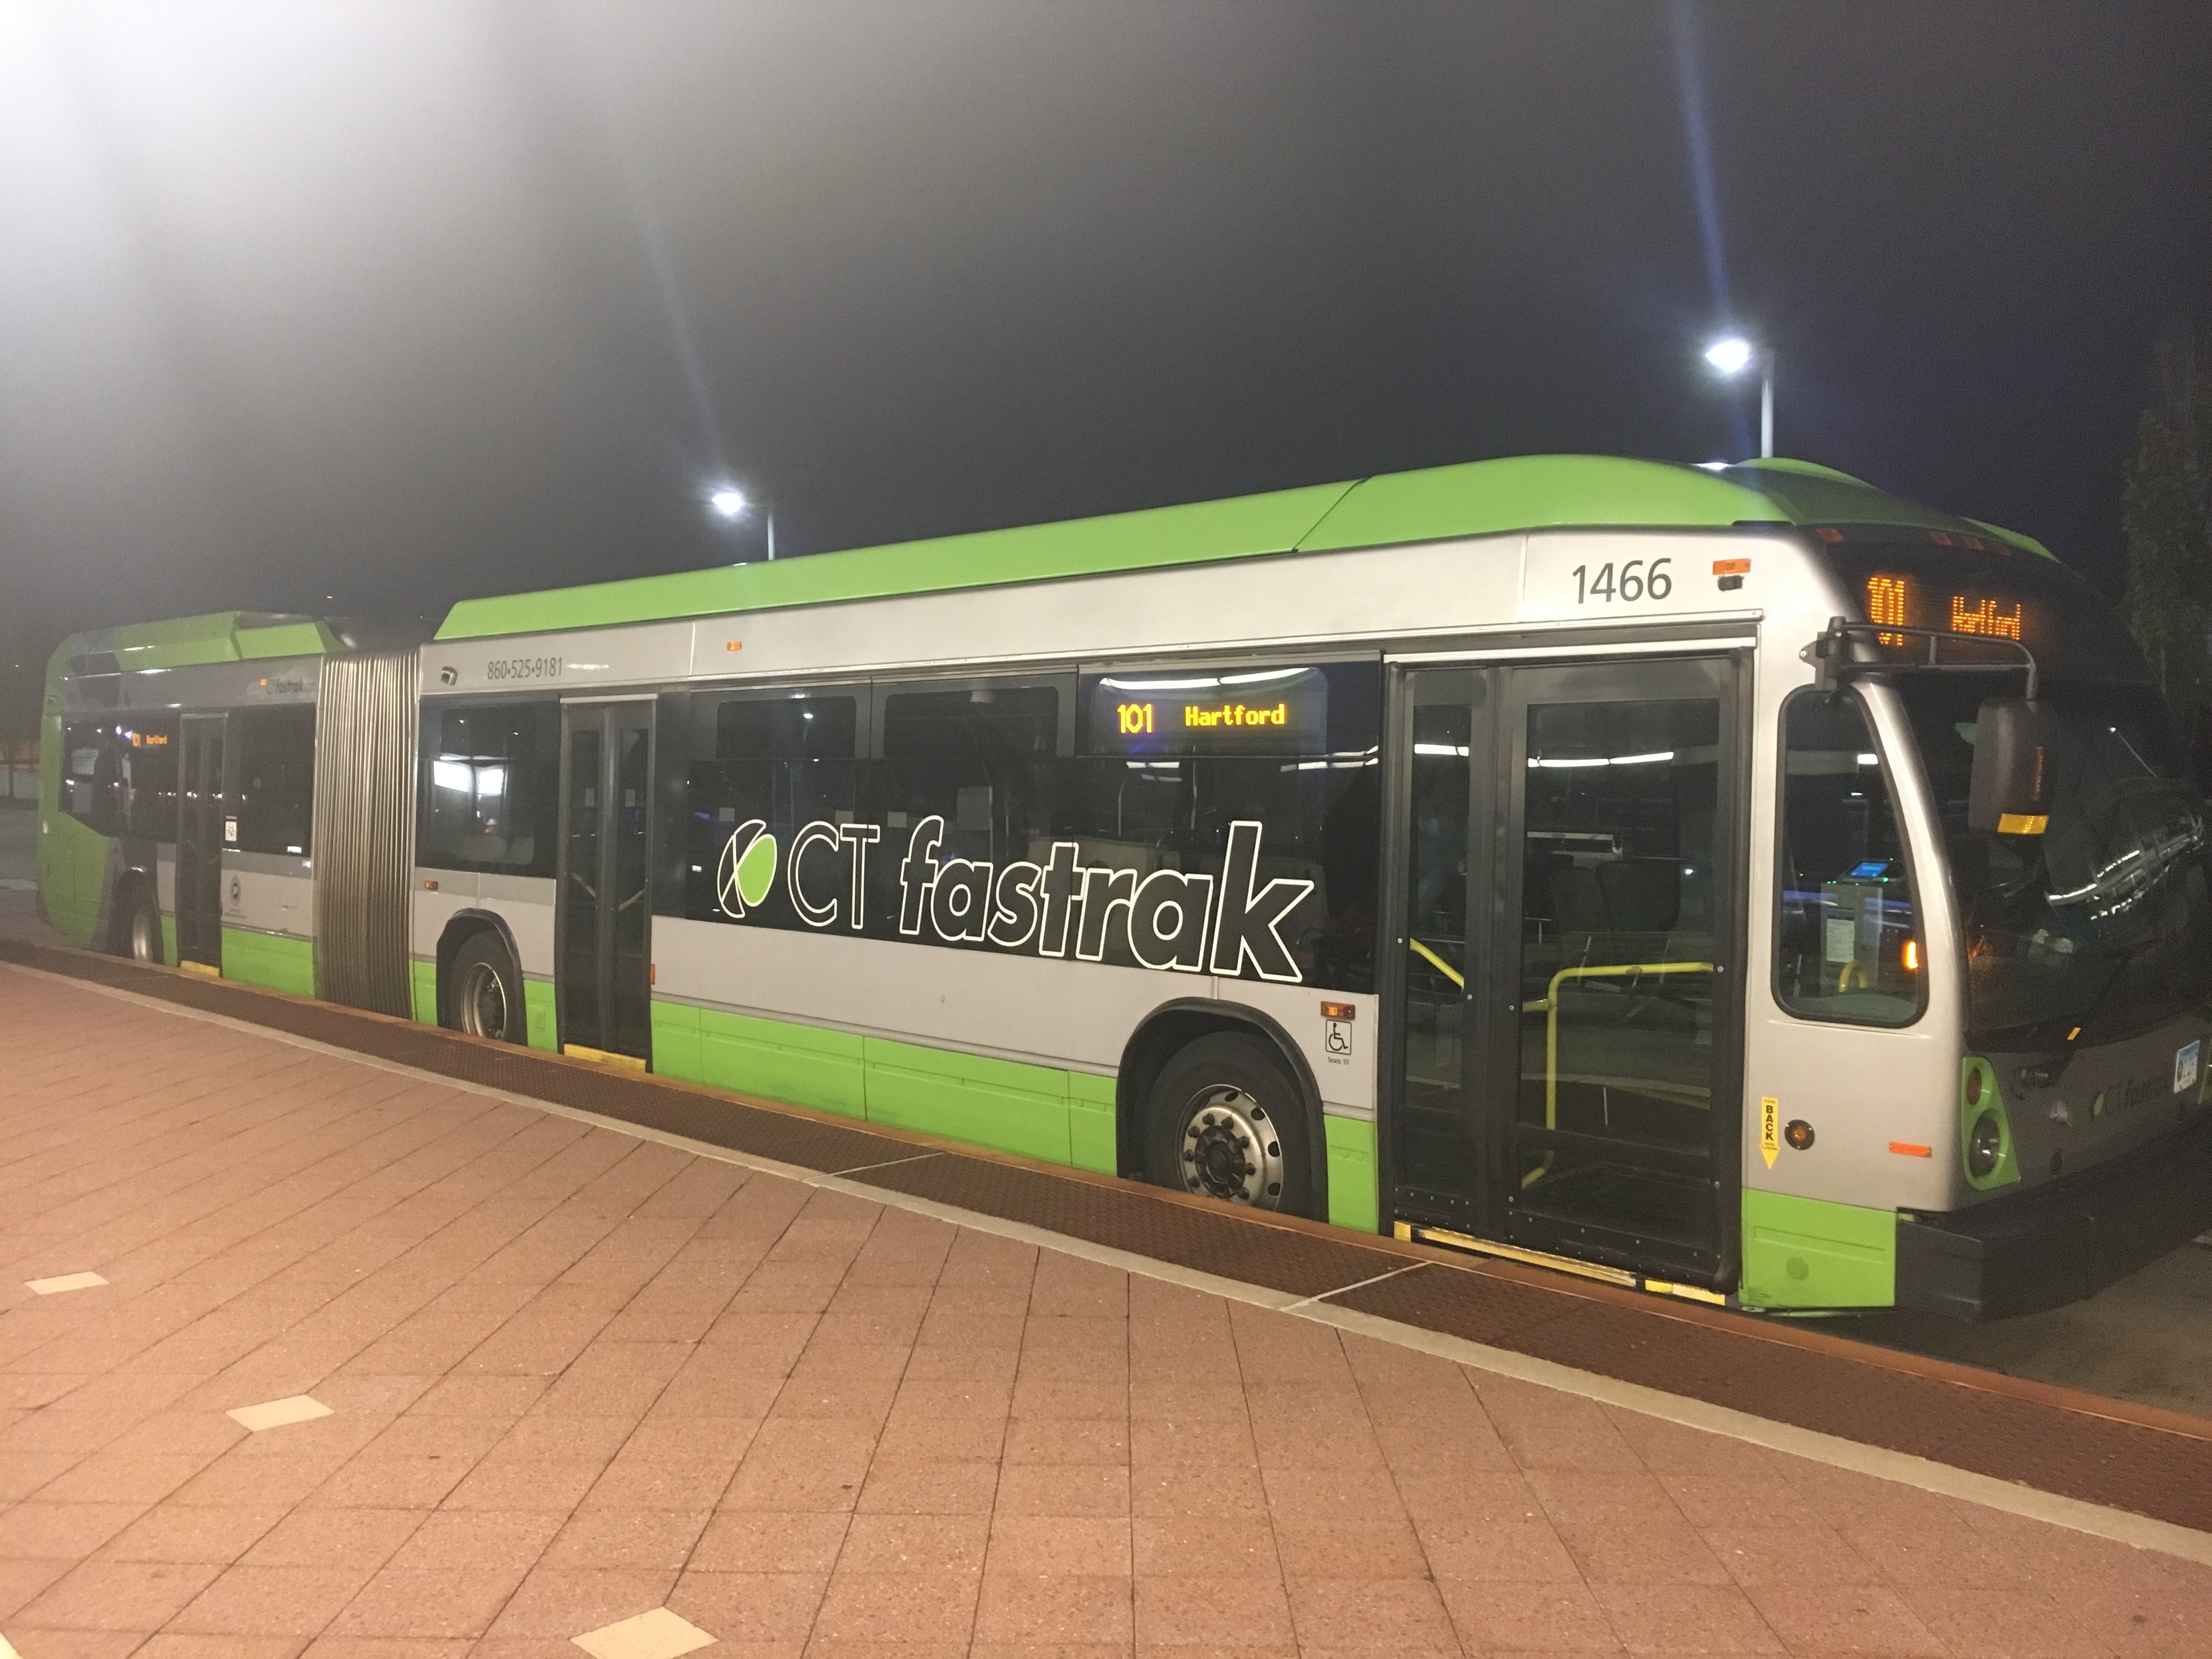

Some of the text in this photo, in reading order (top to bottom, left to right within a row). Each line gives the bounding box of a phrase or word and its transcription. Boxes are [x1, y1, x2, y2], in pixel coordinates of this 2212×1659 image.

[1572, 557, 1672, 604] 1466
[1867, 577, 1904, 646] 101
[1117, 703, 1285, 733] 101 Hartford
[787, 815, 1314, 982] CT fastrak
[1328, 1056, 1341, 1064] Seats
[1765, 1104, 1774, 1141] BACK
